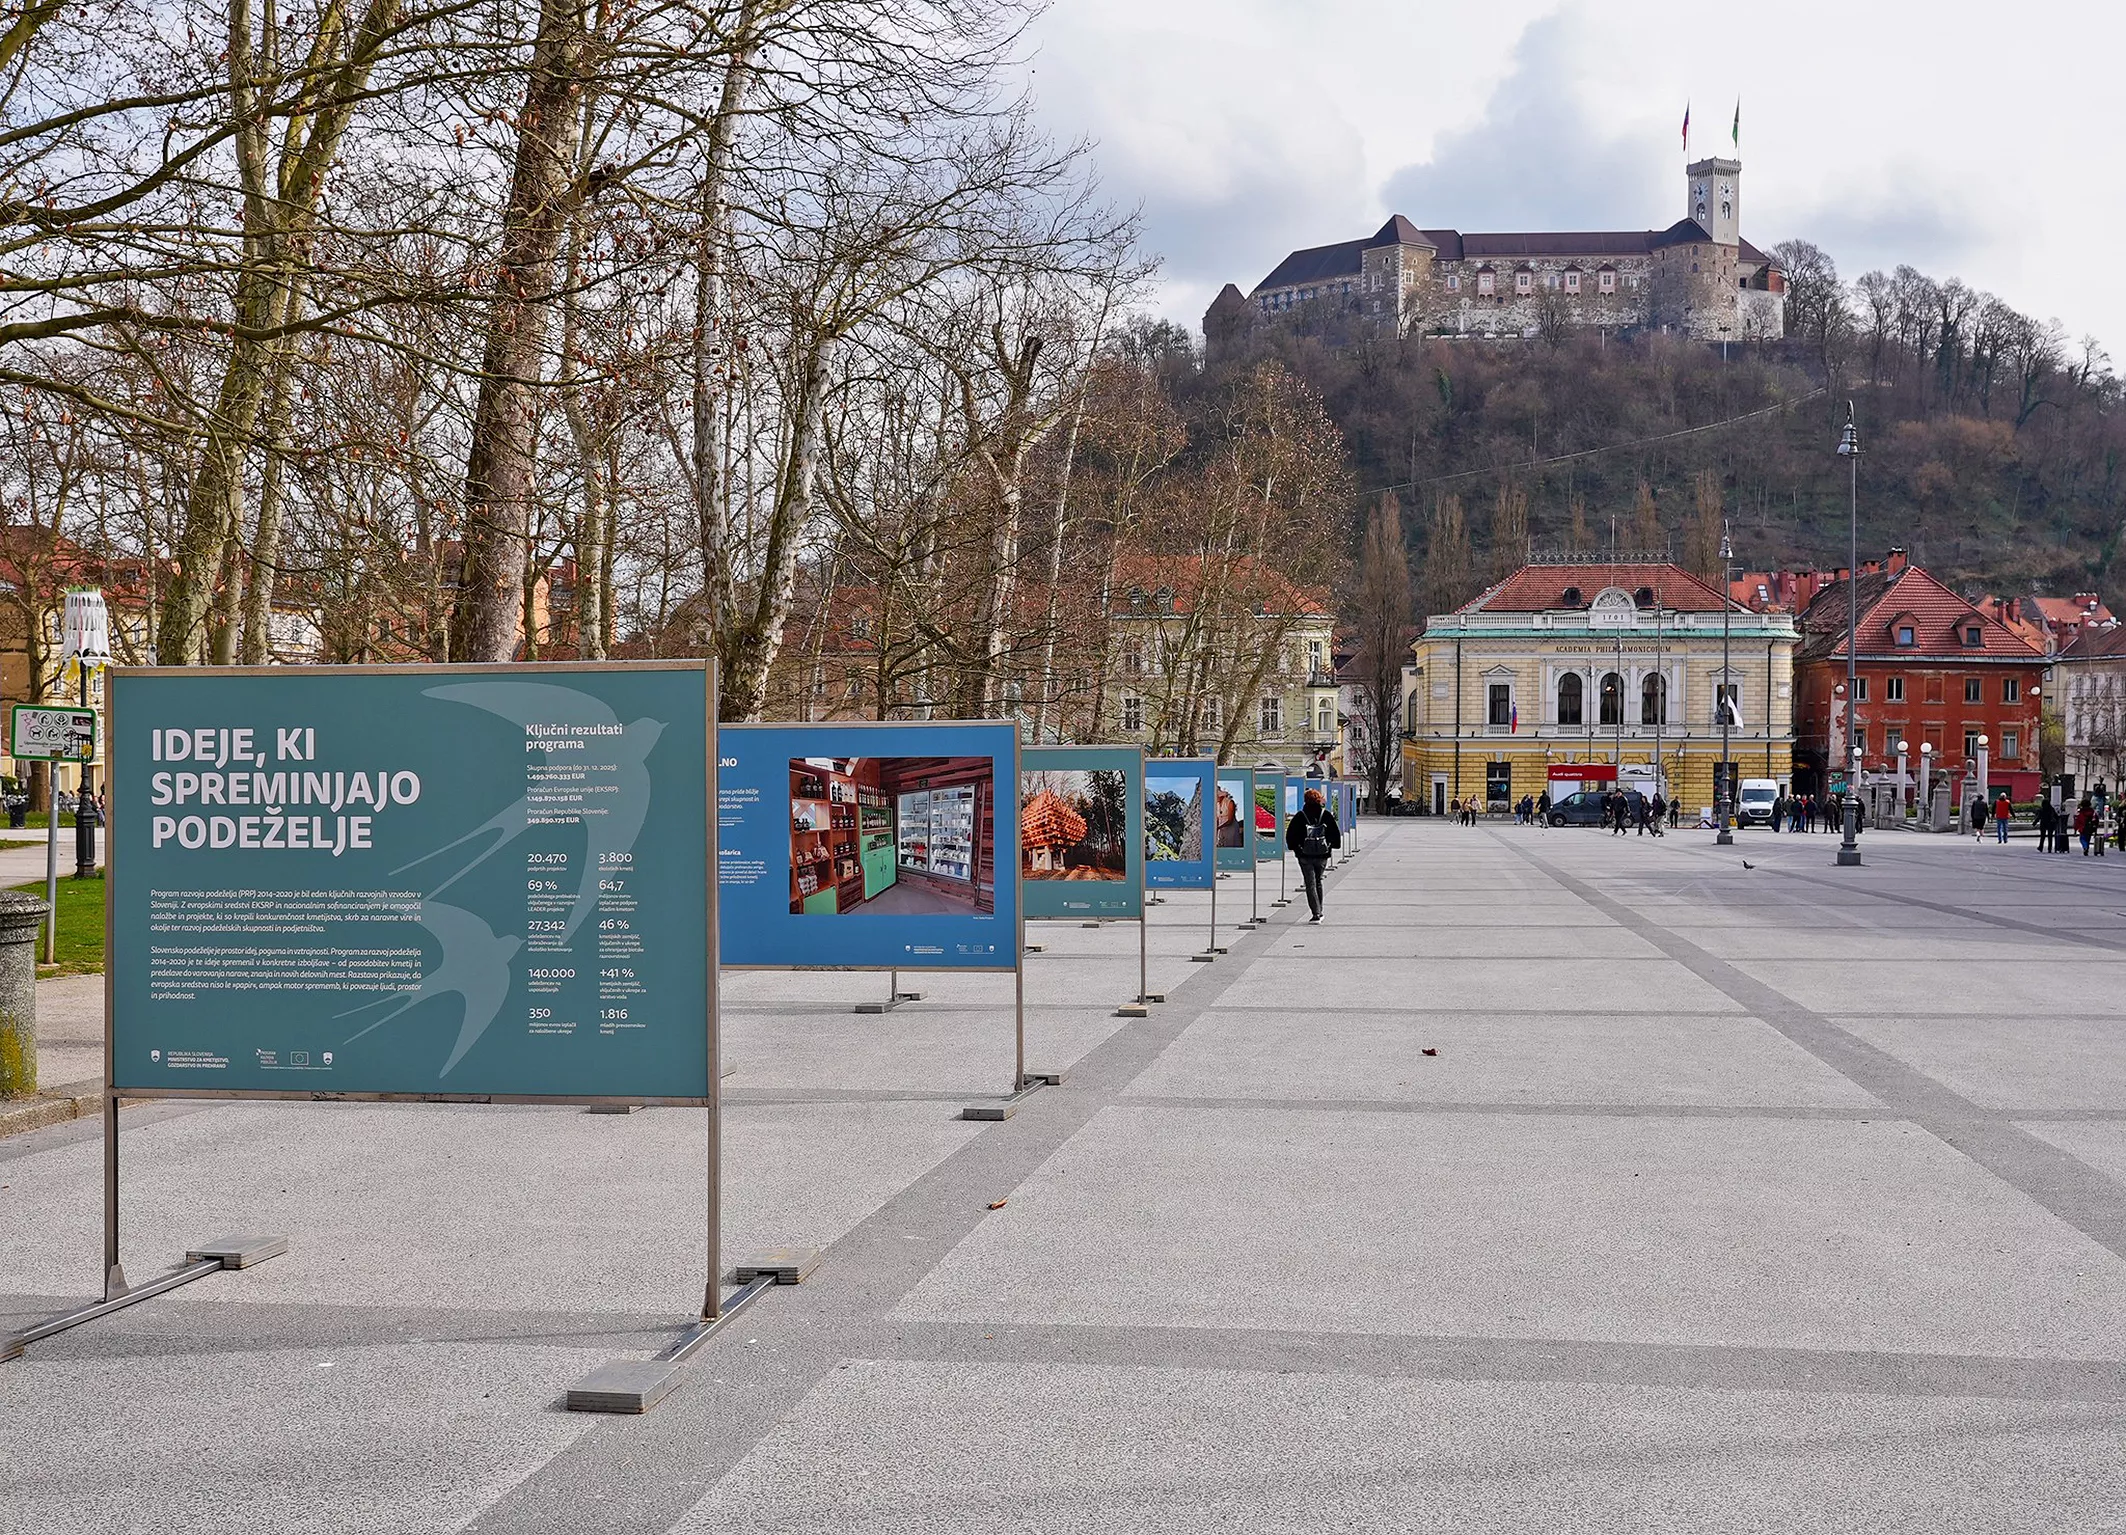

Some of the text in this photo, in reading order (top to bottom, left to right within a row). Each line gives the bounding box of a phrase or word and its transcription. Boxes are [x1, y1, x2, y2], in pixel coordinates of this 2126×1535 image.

[526, 723, 622, 738] Ključni rezultati
[152, 728, 315, 769] IDEJE, KI
[526, 740, 585, 752] programa
[151, 770, 421, 813] SPREMINJAJO
[152, 805, 372, 857] PODEŽELJE
[527, 853, 567, 864] 20.470
[598, 852, 632, 864] 3.800
[527, 880, 557, 891] 69 %
[599, 880, 624, 891] 64,7
[150, 890, 179, 899] Program
[181, 890, 204, 899] razvoja
[206, 890, 237, 899] podeželja
[238, 890, 256, 899] (PRP)
[293, 890, 300, 899] je
[328, 890, 355, 899] ključnih
[356, 890, 387, 899] razvojnih
[150, 901, 179, 910] Sloveniji.
[187, 902, 223, 910] evropskimi
[327, 902, 380, 911] sofinanciranjem
[382, 902, 388, 911] je
[390, 902, 421, 911] omogočil
[150, 924, 170, 933] okolje
[181, 924, 202, 933] razvoj
[202, 924, 241, 933] podeželskih
[242, 924, 274, 933] skupnosti
[282, 925, 325, 934] podjetništva.
[528, 920, 566, 931] 27.342
[599, 919, 629, 930] 46 %
[528, 968, 576, 978] 140.000
[600, 968, 634, 978] +41 %
[158, 992, 195, 1001] prihodnost.
[529, 1008, 550, 1019] 350
[600, 1008, 628, 1019] 1.816
